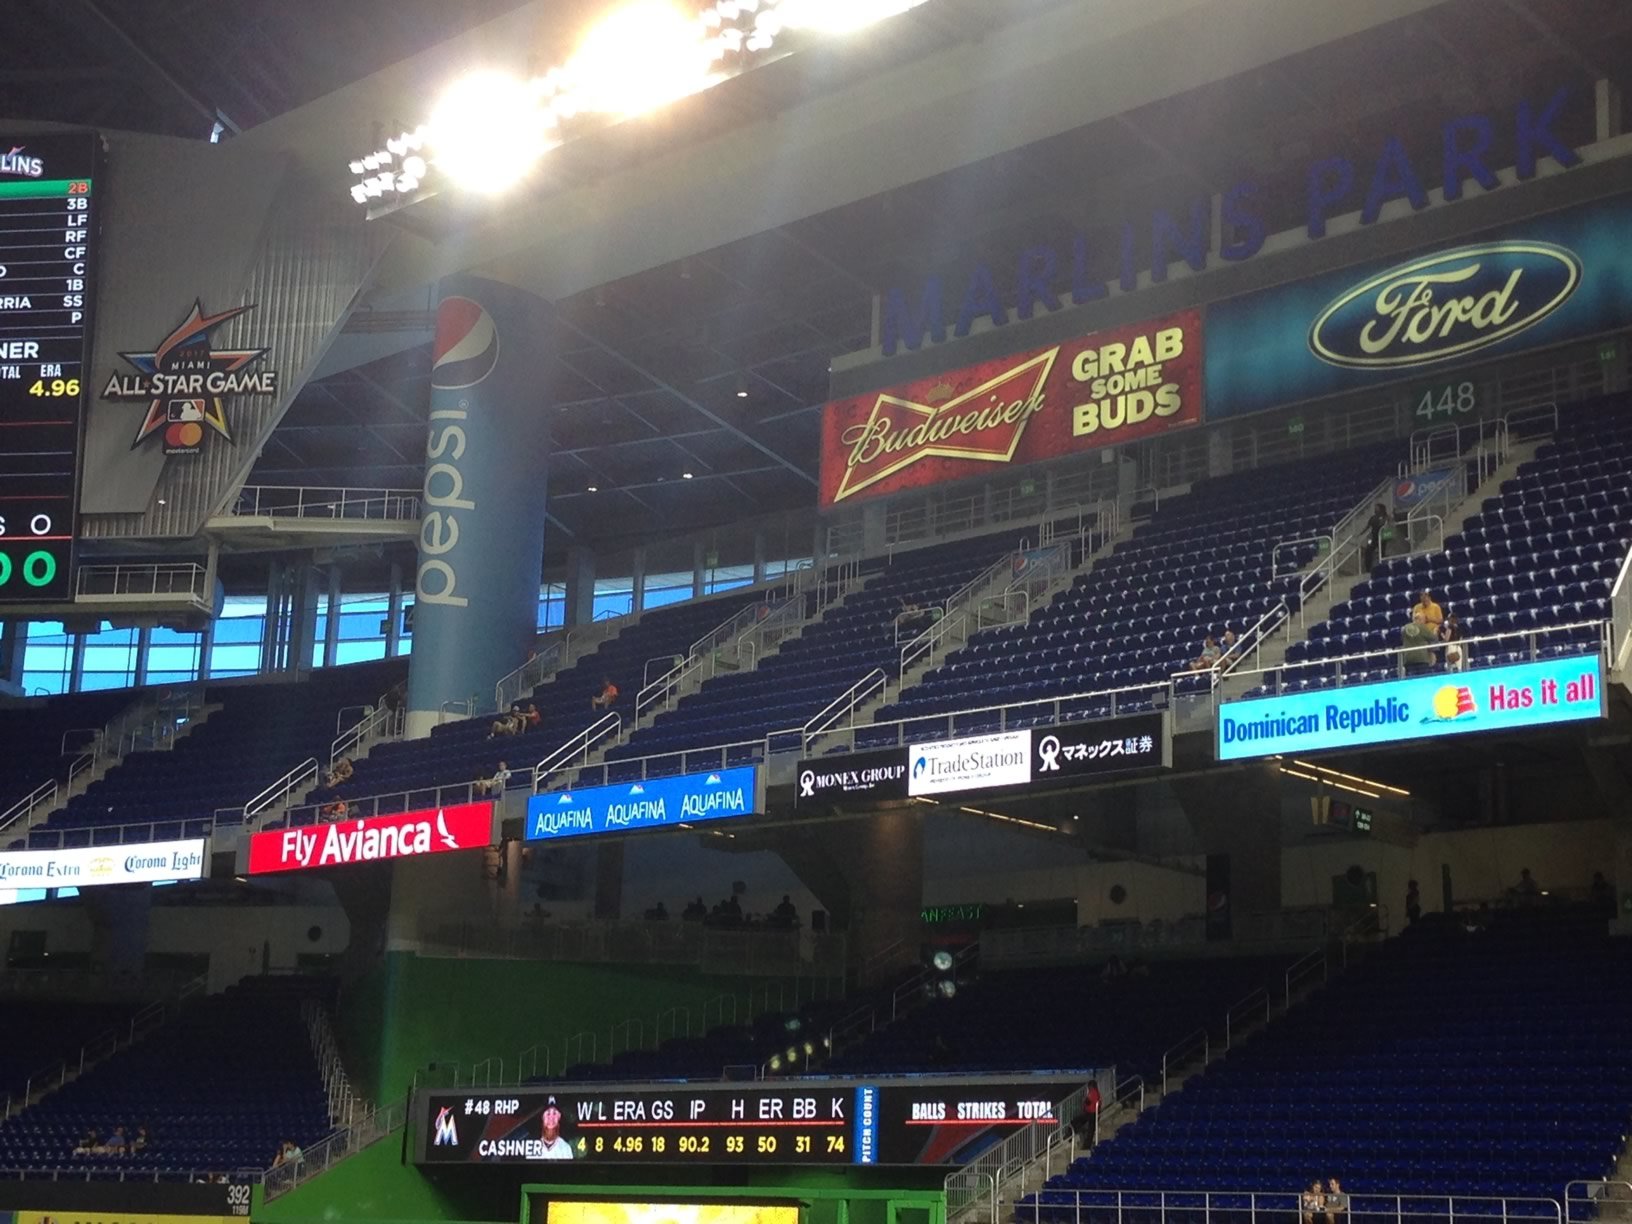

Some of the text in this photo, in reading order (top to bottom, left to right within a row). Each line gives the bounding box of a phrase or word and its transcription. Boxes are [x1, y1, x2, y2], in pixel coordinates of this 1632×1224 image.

[68, 182, 89, 195] 2B
[66, 198, 88, 210] 3B
[67, 214, 88, 226] LF
[881, 84, 1583, 356] MARLINS PARK
[65, 230, 87, 243] RF
[64, 247, 86, 259] CF
[73, 263, 85, 275] C
[66, 279, 84, 291] 1B
[63, 295, 83, 307] SS
[1359, 263, 1523, 353] Ford
[71, 311, 82, 324] P
[1072, 327, 1183, 382] GRAB
[40, 364, 62, 377] ERA
[171, 361, 211, 371] MIAMI
[29, 379, 80, 397] 4.96
[103, 371, 275, 396] ALL STAR GAME
[1090, 364, 1163, 400] SOME
[1073, 383, 1182, 437] BUDS
[1416, 382, 1476, 420] 448
[841, 390, 1047, 467] Budweiser
[415, 410, 476, 607] pepsi
[30, 514, 51, 535] O
[23, 550, 56, 587] 0
[1223, 673, 1595, 744] Dominican Republic Has it all
[1061, 735, 1153, 761] マネックス証券
[927, 748, 1024, 777] TradeStation
[816, 770, 859, 788] MONEX
[861, 765, 905, 783] GROUP
[605, 798, 666, 828] AQUAFINA
[680, 788, 745, 819] AQUAFINA
[535, 807, 593, 836] AQUAFINA
[281, 820, 432, 867] Fly Avianca
[47, 861, 80, 877] Extra
[124, 856, 167, 873] Corona
[464, 1099, 519, 1115] #48 RHP
[577, 1098, 844, 1121] W L ERA GS IP H ER BB K
[912, 1101, 1053, 1120] BALLS STRIKES TOTAL
[862, 1088, 873, 1163] PITCH COUNT
[479, 1138, 542, 1156] CASHNER
[577, 1136, 845, 1153] 4 8 4.96 18 90.2 93 50 31 74
[226, 1185, 250, 1204] 392
